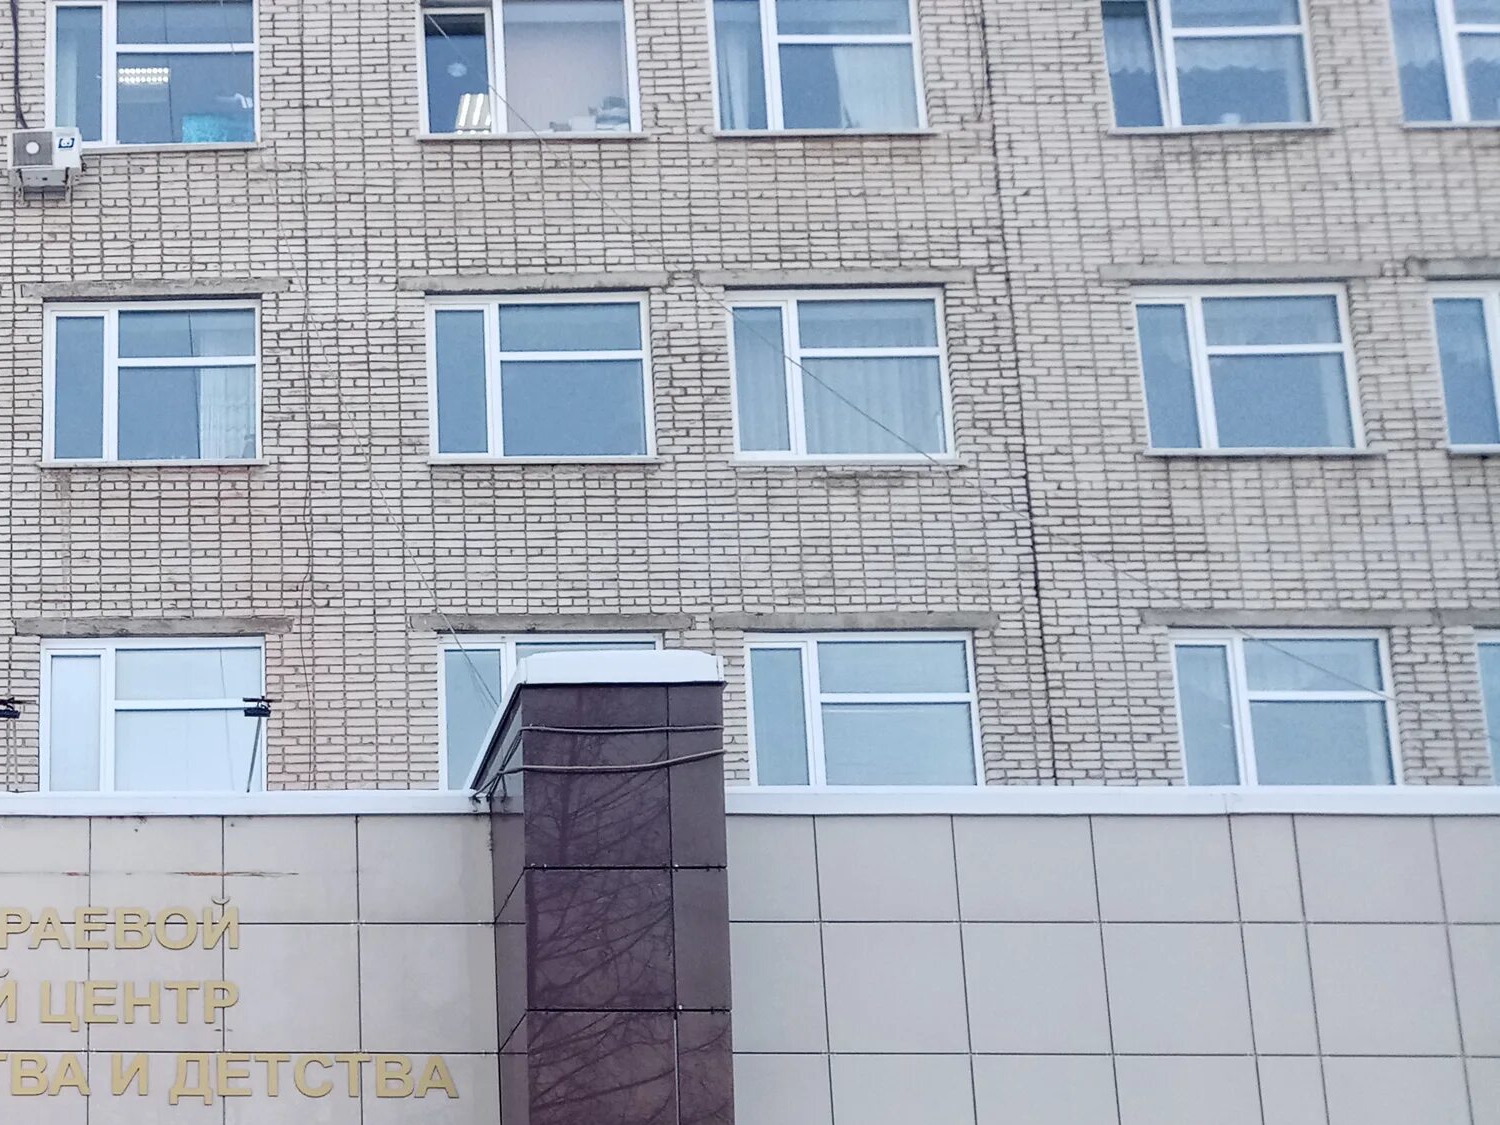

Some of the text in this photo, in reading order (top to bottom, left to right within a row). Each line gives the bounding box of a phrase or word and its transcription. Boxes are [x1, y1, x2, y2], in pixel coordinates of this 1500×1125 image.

[40, 980, 240, 1032] ЦЕНТР
[111, 1053, 149, 1096] И
[168, 1053, 460, 1106] ДЕТСТВА
